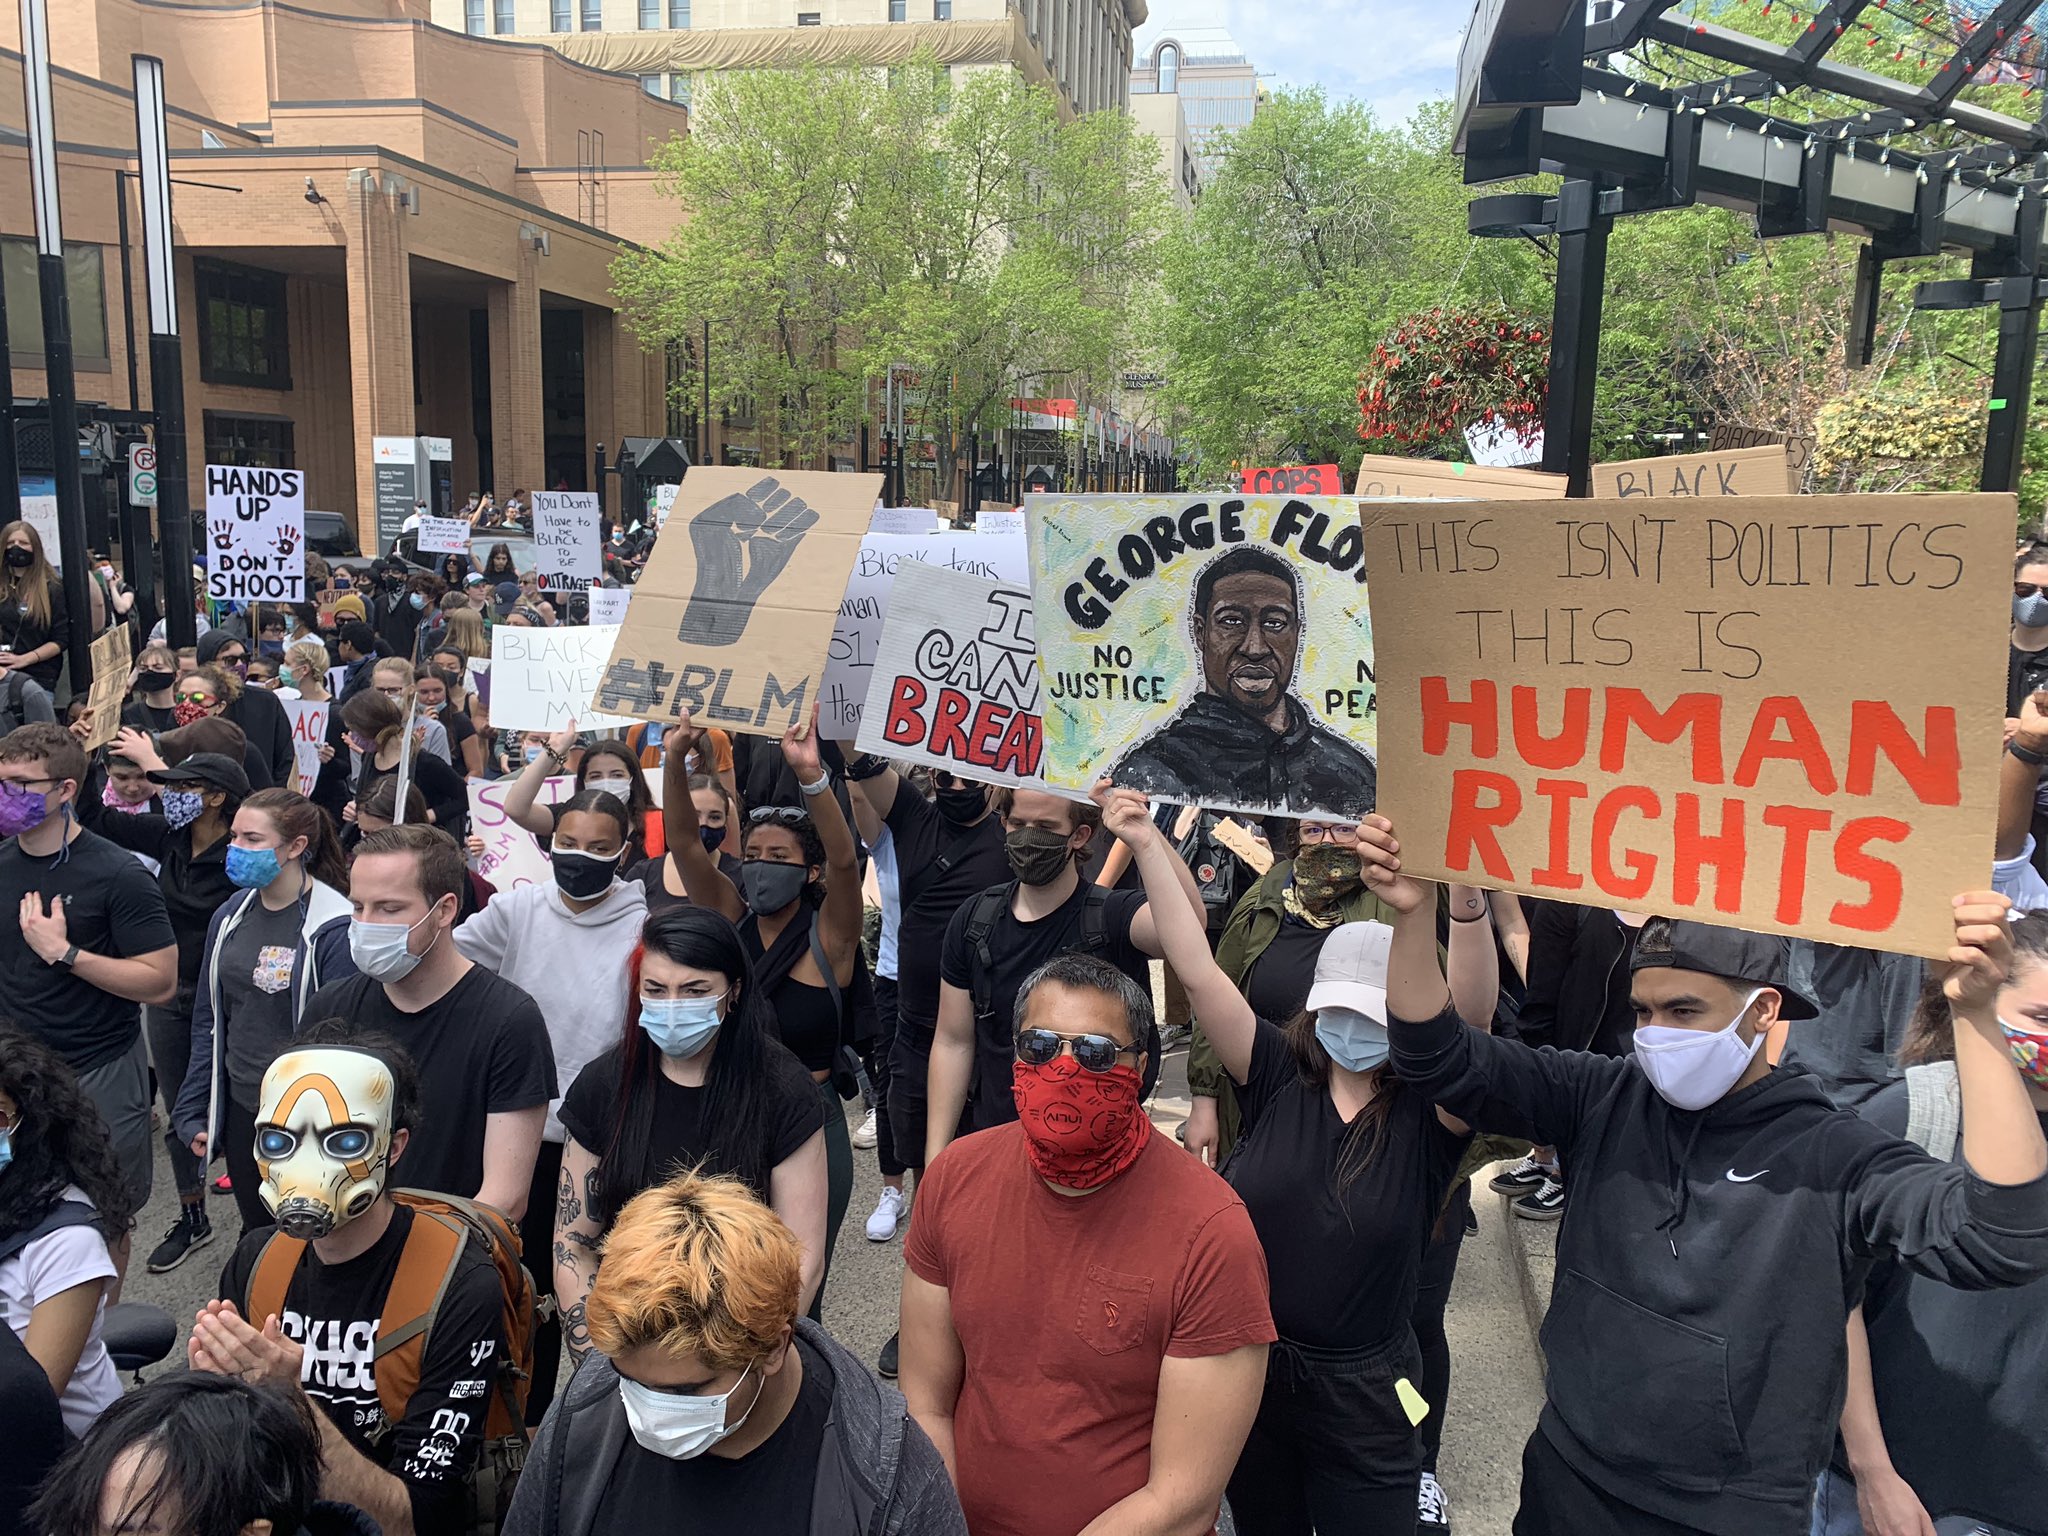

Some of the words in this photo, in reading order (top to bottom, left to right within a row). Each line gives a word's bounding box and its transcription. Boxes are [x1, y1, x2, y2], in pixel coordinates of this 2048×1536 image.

[208, 468, 298, 498] HANDS
[1254, 468, 1321, 494] COPS
[1616, 463, 1738, 497] BLACK
[236, 497, 271, 522] UP
[544, 516, 572, 526] Have
[578, 516, 591, 527] to
[536, 532, 582, 546] BLACK
[1382, 519, 1499, 573] THIS
[1556, 514, 1676, 583] ISN'T
[1707, 519, 1966, 589] POLITICS
[1064, 500, 1245, 630] GEORGE
[1270, 500, 1368, 584] FLO
[210, 573, 303, 599] SHOOT
[538, 572, 601, 591] OUTRAGED
[503, 634, 600, 663] BLACK
[1094, 645, 1132, 669] NO
[1456, 609, 1632, 666] THIS
[1682, 611, 1762, 679] IS
[599, 658, 810, 728] #BLM
[1051, 672, 1167, 703] JUSTICE
[1420, 676, 1962, 806] HUMAN
[478, 832, 517, 877] #BLM
[1445, 769, 1913, 932] RIGHTS
